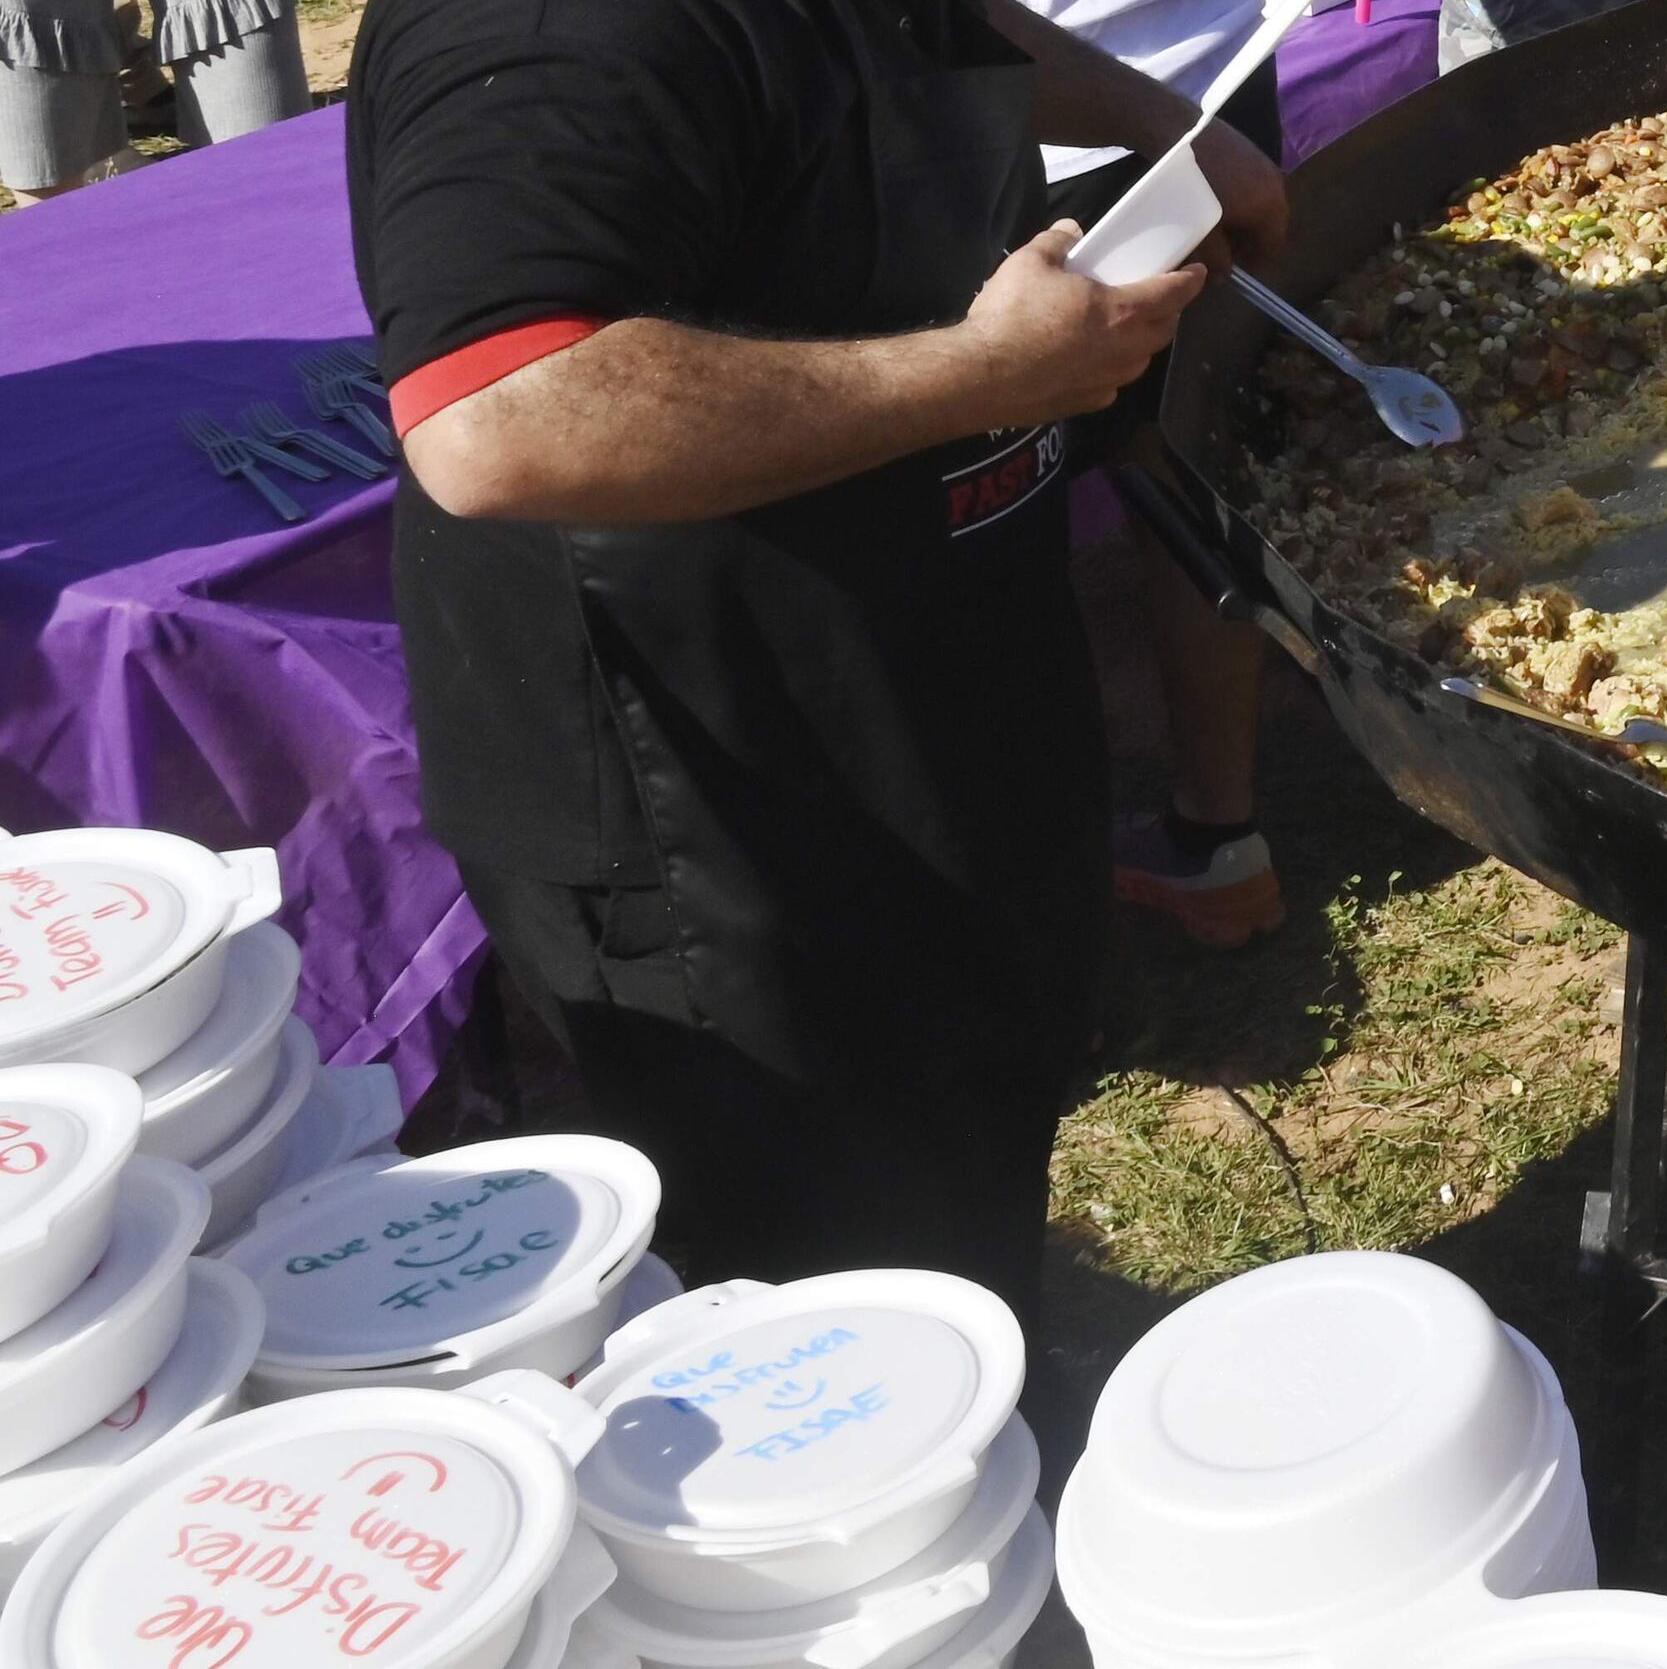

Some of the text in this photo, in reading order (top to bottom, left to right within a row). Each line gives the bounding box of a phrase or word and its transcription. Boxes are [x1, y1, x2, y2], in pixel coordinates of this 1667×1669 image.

[49, 913, 104, 992] Team
[285, 1236, 371, 1275] Que
[184, 1474, 468, 1592] Team Fisae
[168, 1523, 423, 1656] Disfrutes
[136, 1594, 254, 1669] Que
